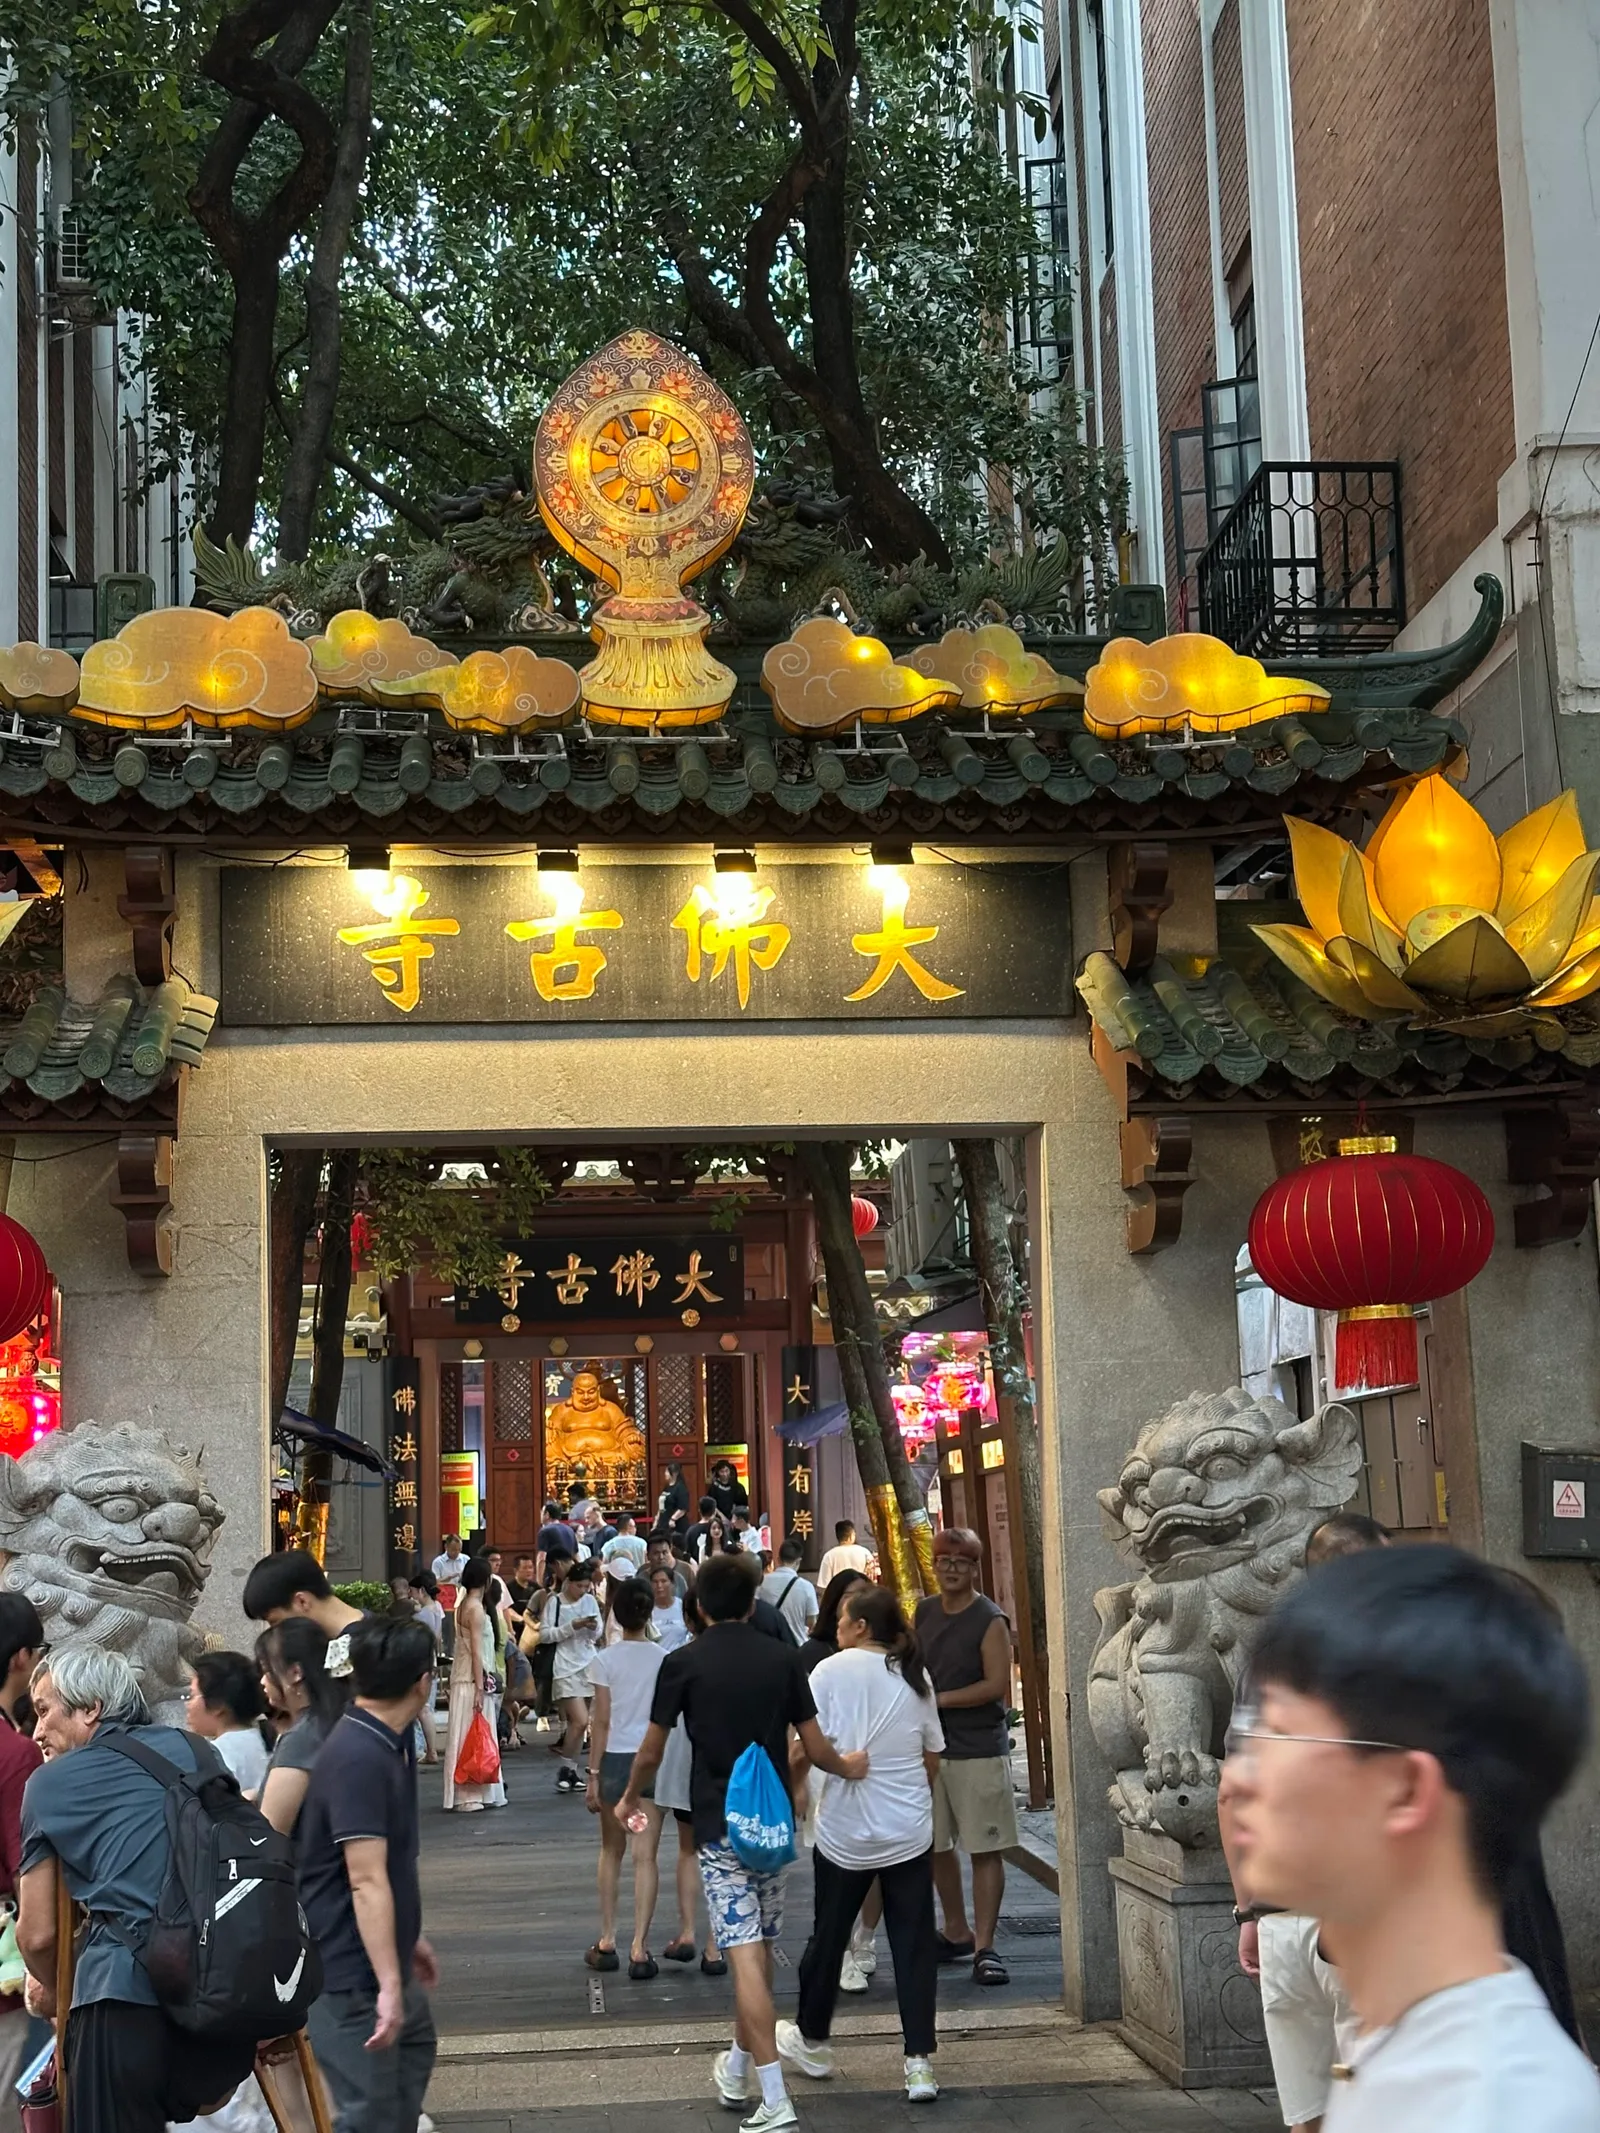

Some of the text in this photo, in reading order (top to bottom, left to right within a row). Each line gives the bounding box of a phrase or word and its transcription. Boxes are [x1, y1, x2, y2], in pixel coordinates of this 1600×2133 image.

[392, 1385, 418, 1553] 佛法無邊
[786, 1374, 815, 1541] 大有岸
